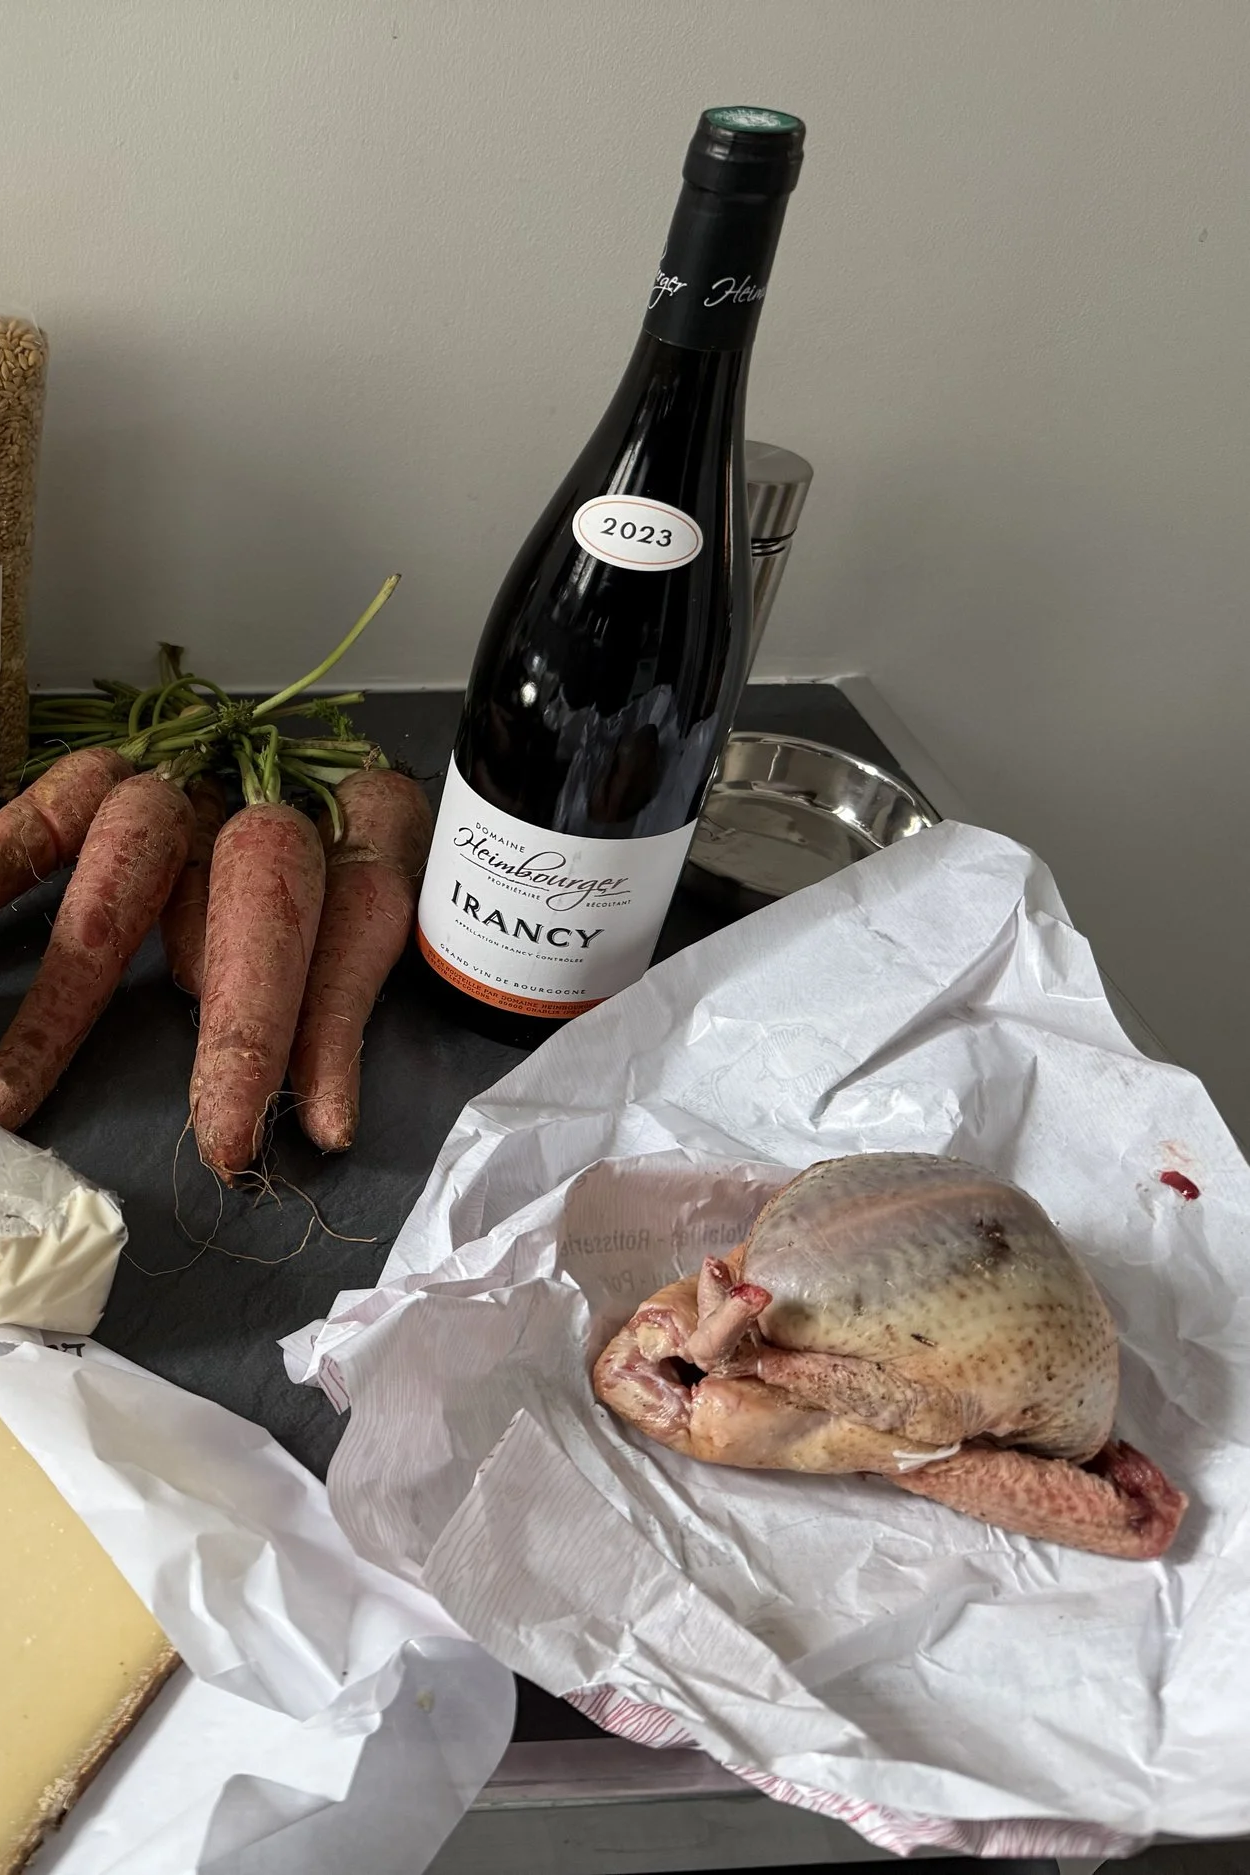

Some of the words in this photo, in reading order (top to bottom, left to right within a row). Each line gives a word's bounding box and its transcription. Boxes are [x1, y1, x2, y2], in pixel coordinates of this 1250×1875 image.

[600, 517, 672, 547] 2023
[475, 821, 525, 854] DOMAINE
[453, 827, 630, 911] Heimbourger
[487, 875, 541, 900] PROPRIÉTAIRE
[586, 899, 632, 907] RÉCOLTANT
[451, 880, 605, 949] IRANCY
[454, 919, 499, 947] APPELLATION
[501, 944, 533, 956] IRANCY
[440, 943, 469, 967] GRAND
[473, 965, 491, 979] VIN
[495, 976, 509, 985] DE
[513, 982, 588, 995] BOURGOGNE
